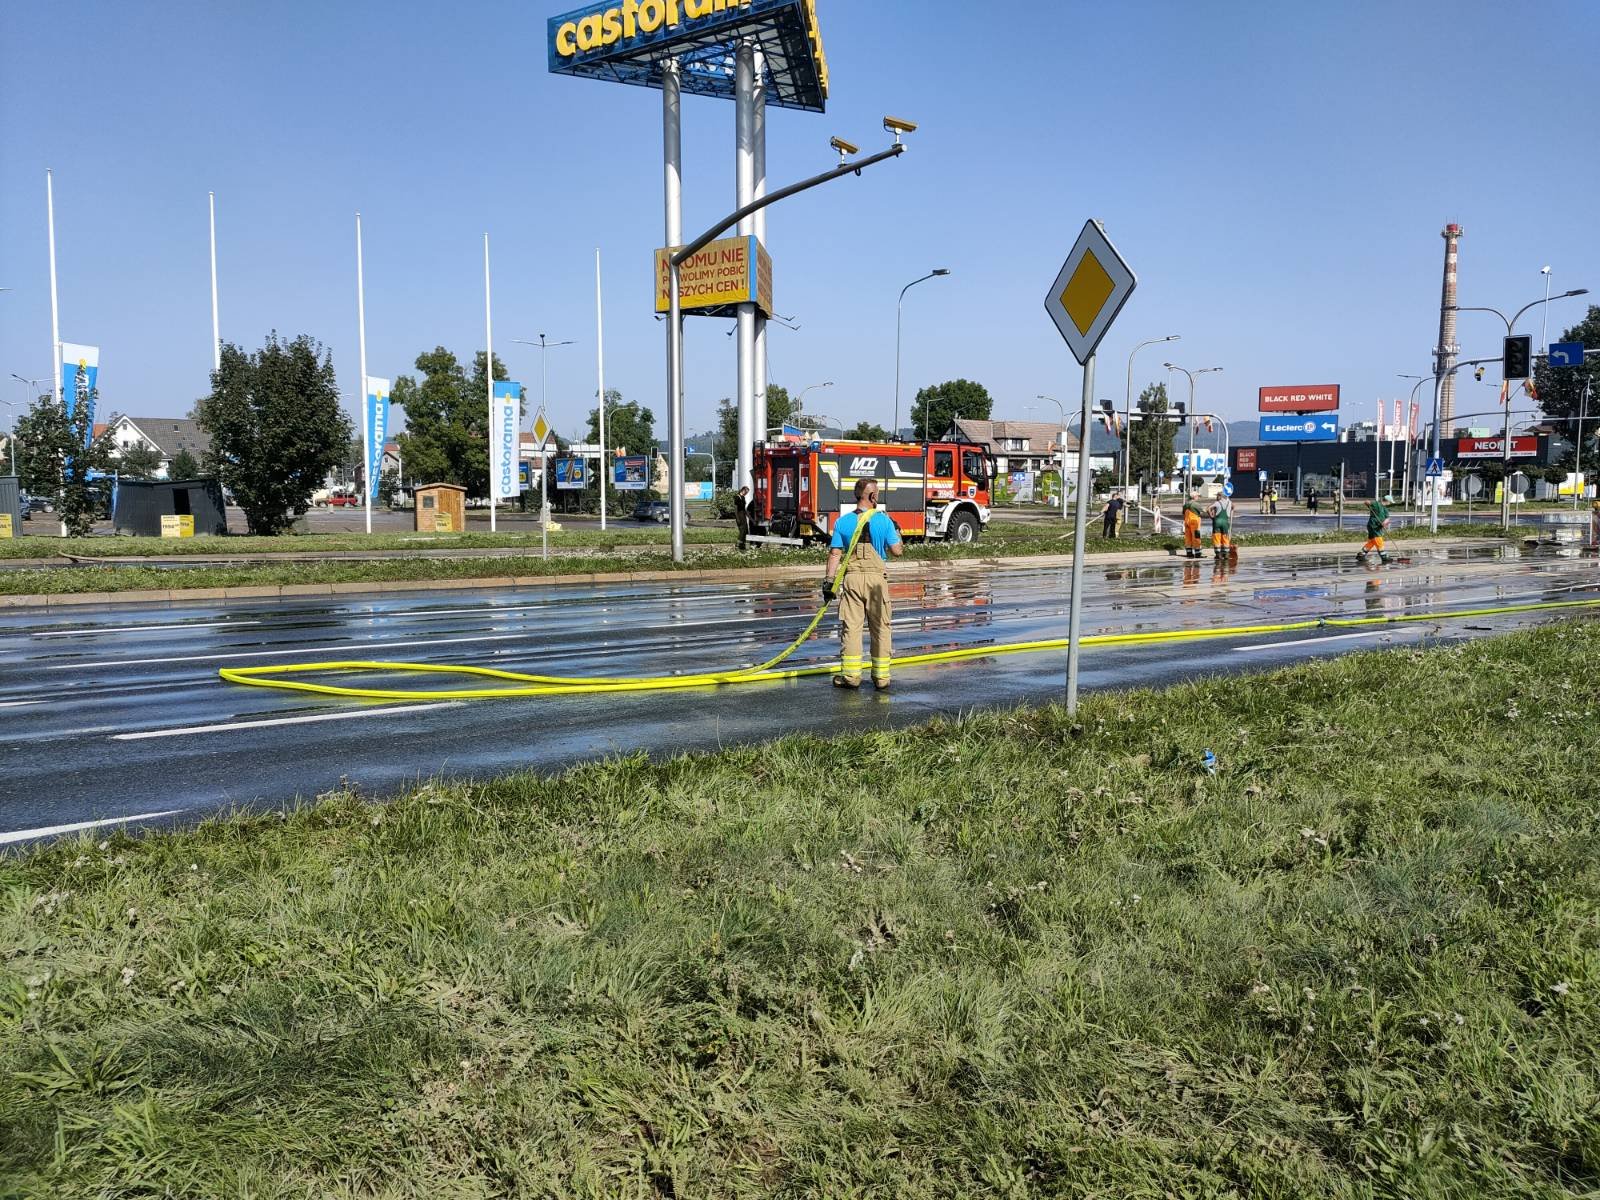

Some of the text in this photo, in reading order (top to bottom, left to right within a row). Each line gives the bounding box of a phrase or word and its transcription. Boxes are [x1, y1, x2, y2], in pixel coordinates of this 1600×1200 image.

[556, 0, 752, 57] castora
[662, 248, 743, 272] NOMU NIE
[663, 263, 744, 284] PWOLIMY POBIĆ
[662, 283, 714, 299] NSZYCH
[716, 280, 738, 292] CEN
[1308, 393, 1333, 401] WHITE
[1265, 424, 1303, 432] E.Leclerc
[502, 406, 514, 494] castorama
[1474, 440, 1518, 450] NEOT
